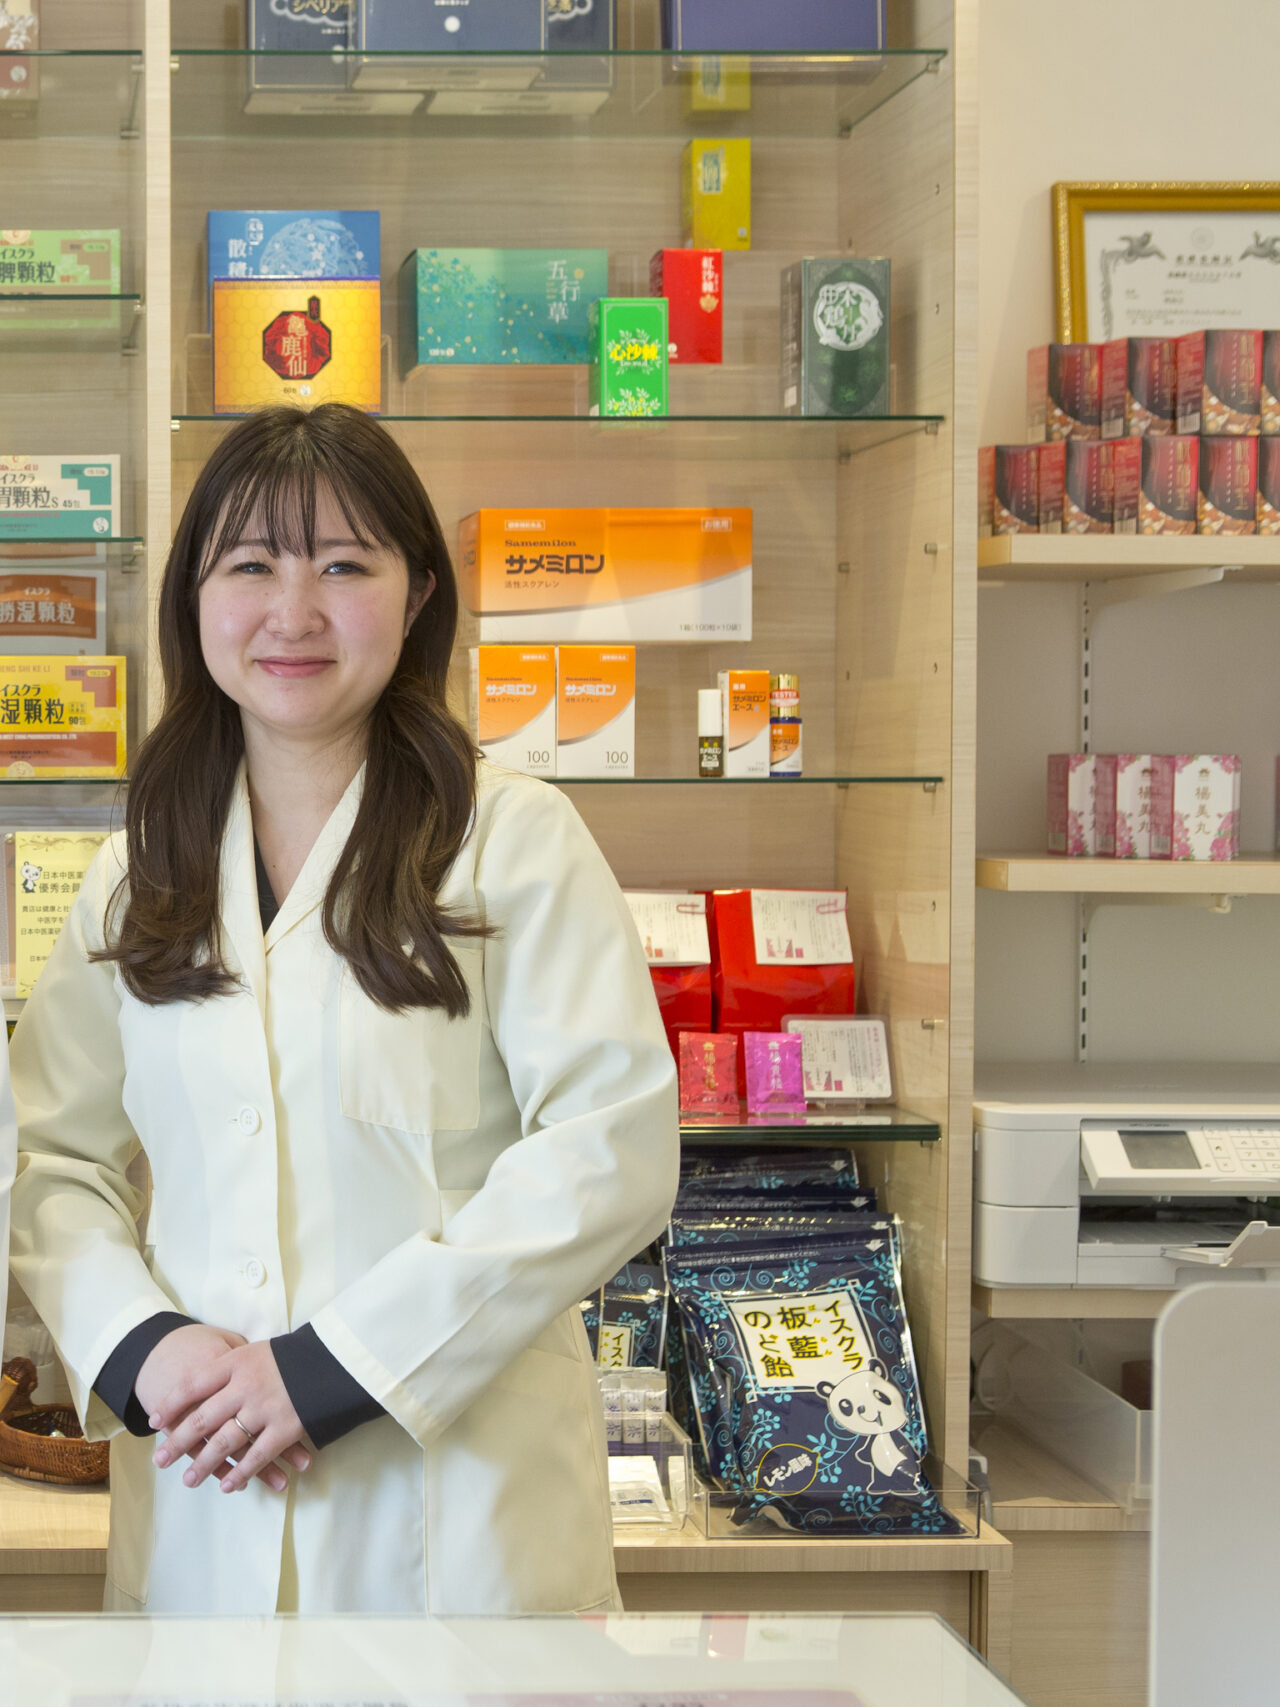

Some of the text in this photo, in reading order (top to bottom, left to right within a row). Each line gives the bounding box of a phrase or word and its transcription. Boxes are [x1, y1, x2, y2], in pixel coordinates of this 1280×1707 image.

[0, 248, 36, 260] イスクラ
[546, 260, 580, 323] 五行草
[0, 473, 36, 485] イスクラ
[505, 554, 605, 575] サメミロン
[505, 580, 560, 589] 活性スクアレン
[0, 684, 41, 697] イスクラ
[485, 684, 537, 696] サメミロン
[565, 684, 616, 696] サメミロン
[526, 751, 550, 764] 100
[605, 751, 629, 764] 100
[776, 1306, 824, 1360] 板藍
[824, 1300, 864, 1371] イスクラ
[744, 1311, 795, 1378] のど飴
[763, 1453, 813, 1487] レモン風味
